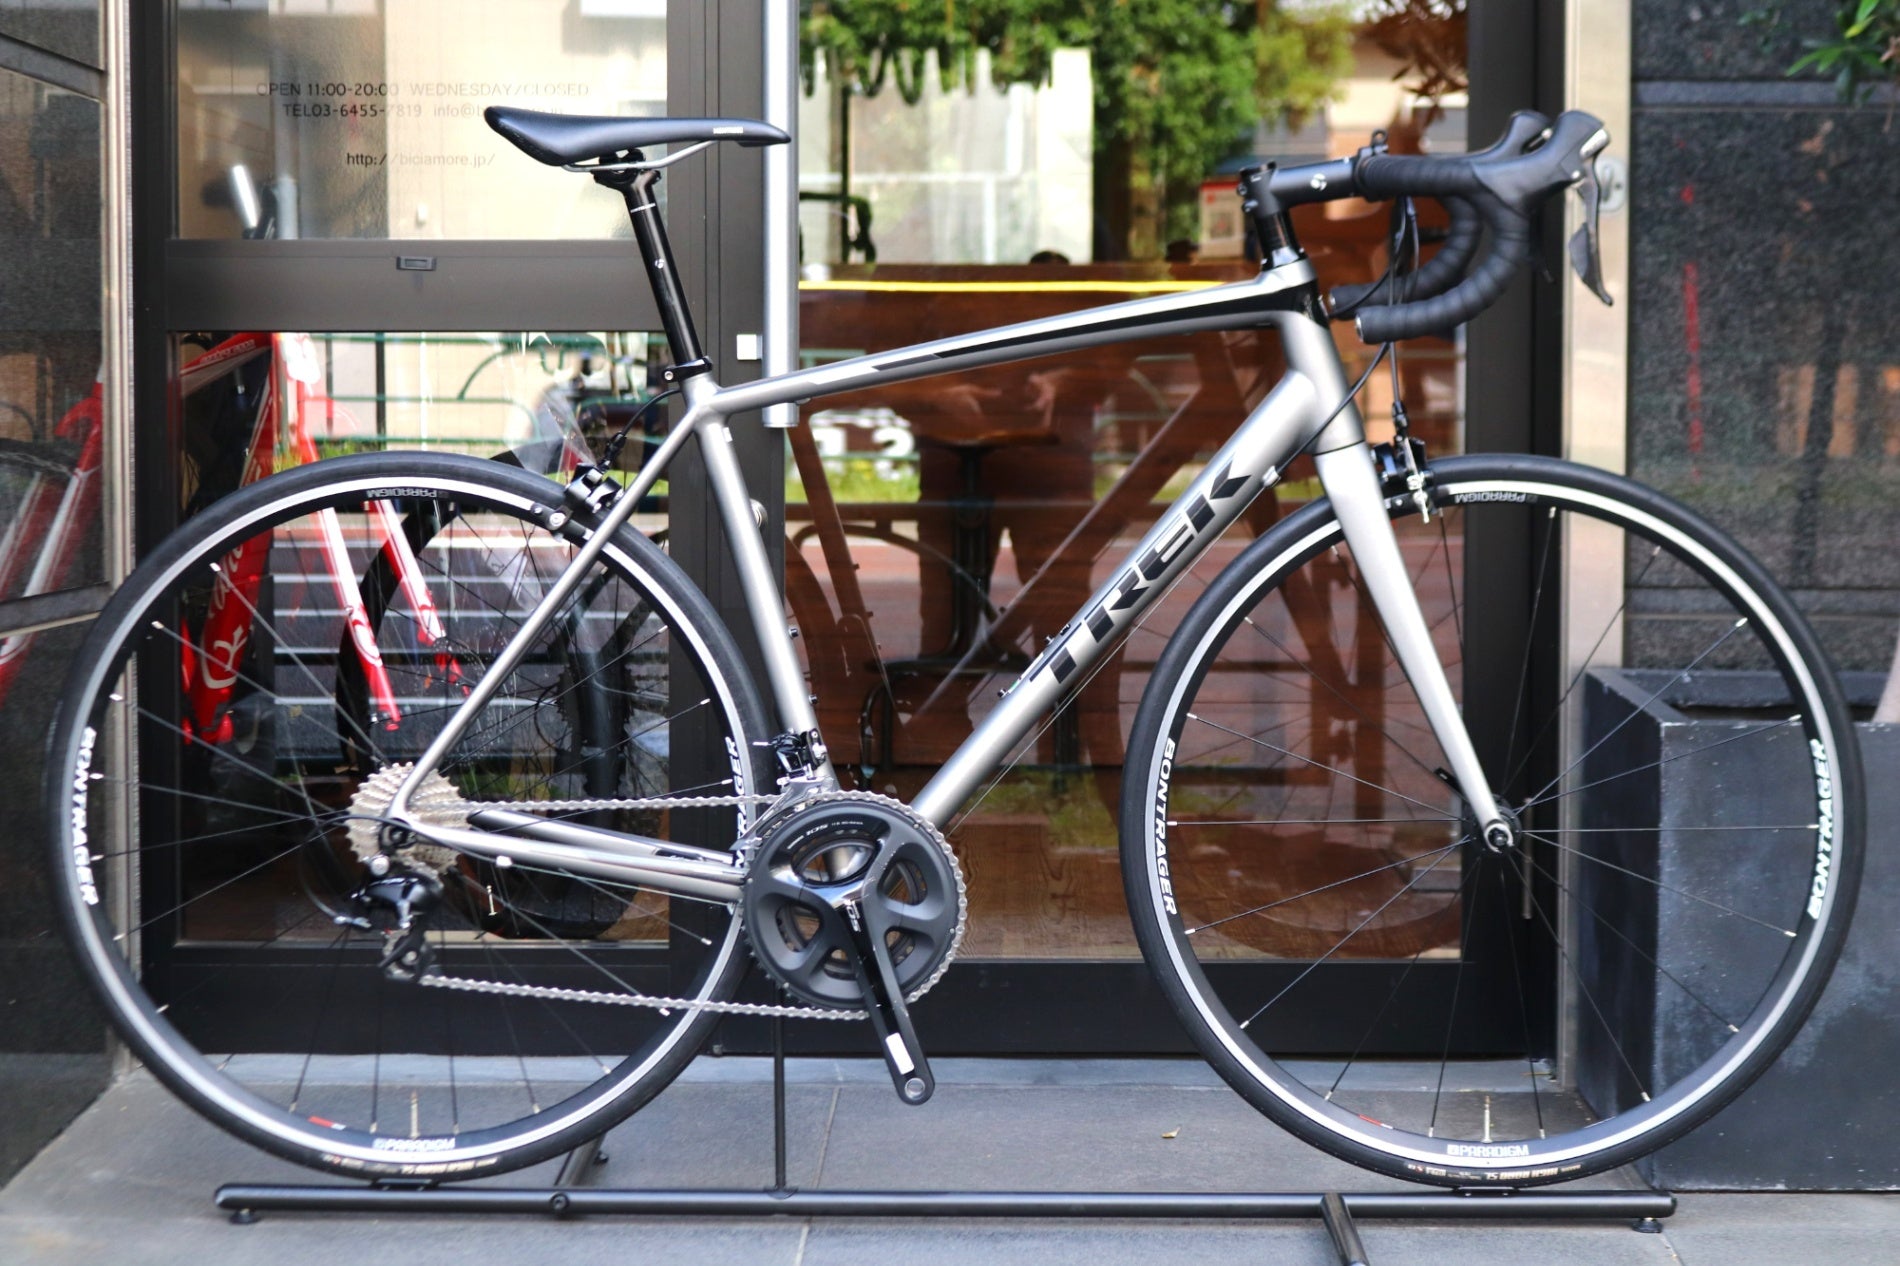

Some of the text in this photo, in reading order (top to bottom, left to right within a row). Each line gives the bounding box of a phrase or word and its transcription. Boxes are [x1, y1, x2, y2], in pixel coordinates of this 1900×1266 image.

[257, 82, 590, 97] OPEN 11:00-20:00 WEDNESDAY/CLOSED
[346, 152, 496, 169] http://biciamore.jp/
[366, 488, 438, 499] PARADIGM
[1455, 491, 1527, 503] PARADIGM
[1028, 452, 1252, 684] TREK
[1154, 736, 1177, 915] BONTRAGER
[1806, 738, 1834, 920] BONTRAGER
[1459, 1143, 1530, 1158] PARADIGM
